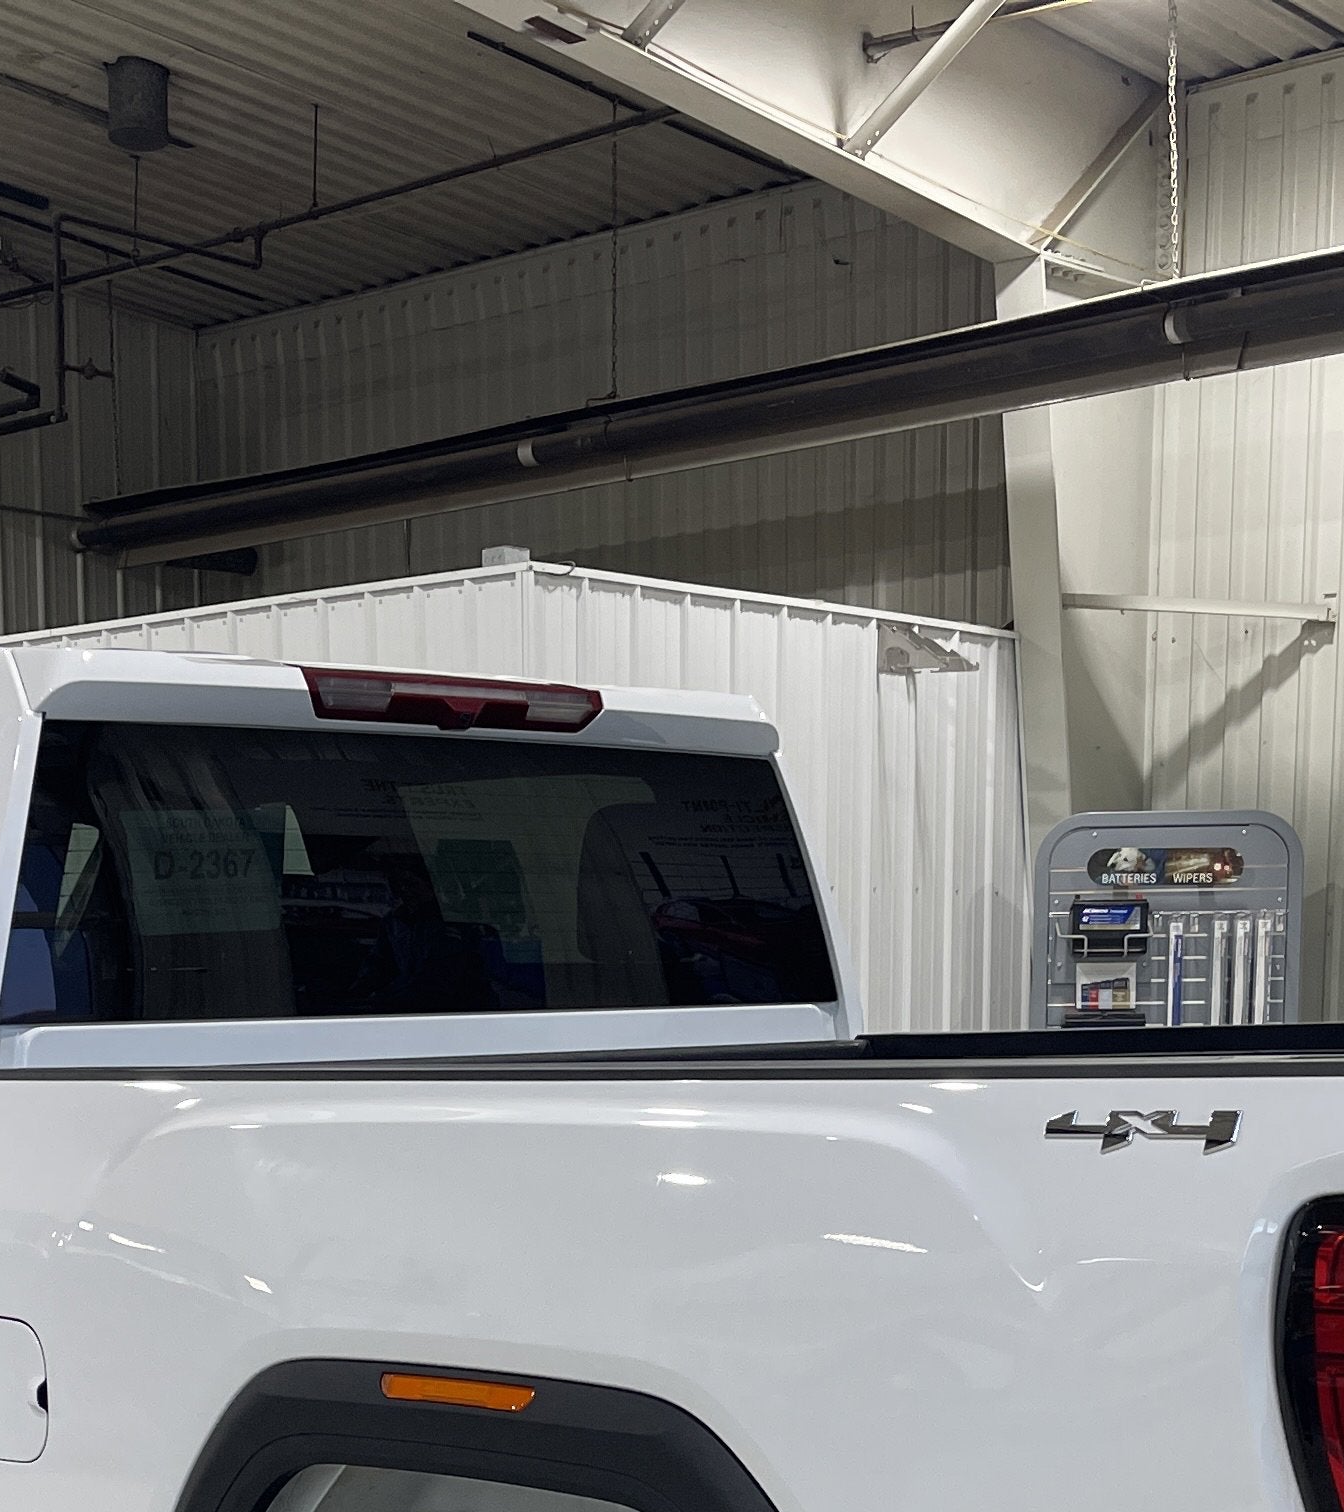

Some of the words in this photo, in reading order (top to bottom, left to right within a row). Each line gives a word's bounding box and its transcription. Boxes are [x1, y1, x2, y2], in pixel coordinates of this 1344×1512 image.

[1101, 873, 1157, 885] BATTERIES
[1173, 872, 1213, 884] WIPERS
[1044, 1110, 1244, 1156] 4X4
